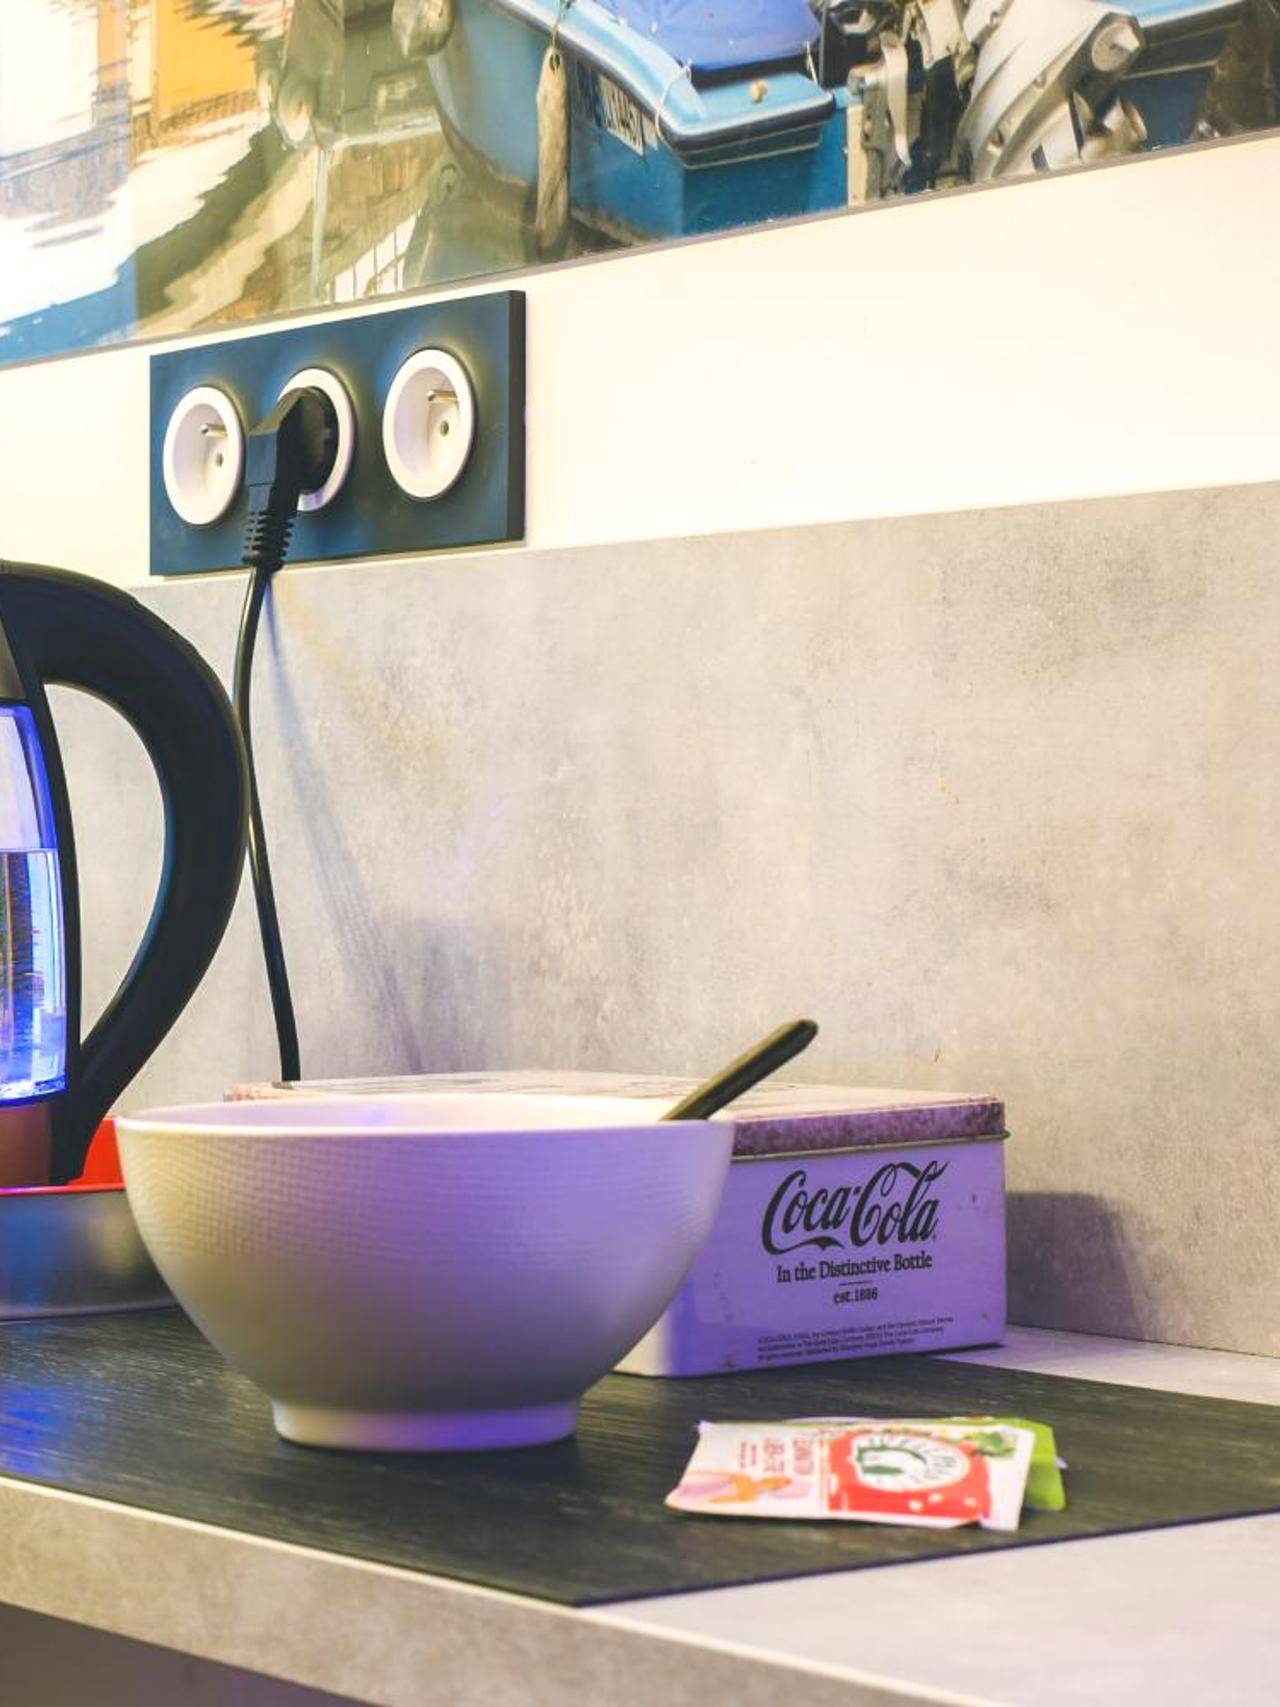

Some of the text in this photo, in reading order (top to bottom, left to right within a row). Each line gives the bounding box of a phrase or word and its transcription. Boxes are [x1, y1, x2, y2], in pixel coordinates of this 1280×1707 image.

[776, 1250, 933, 1283] In the Distinctive Bottle
